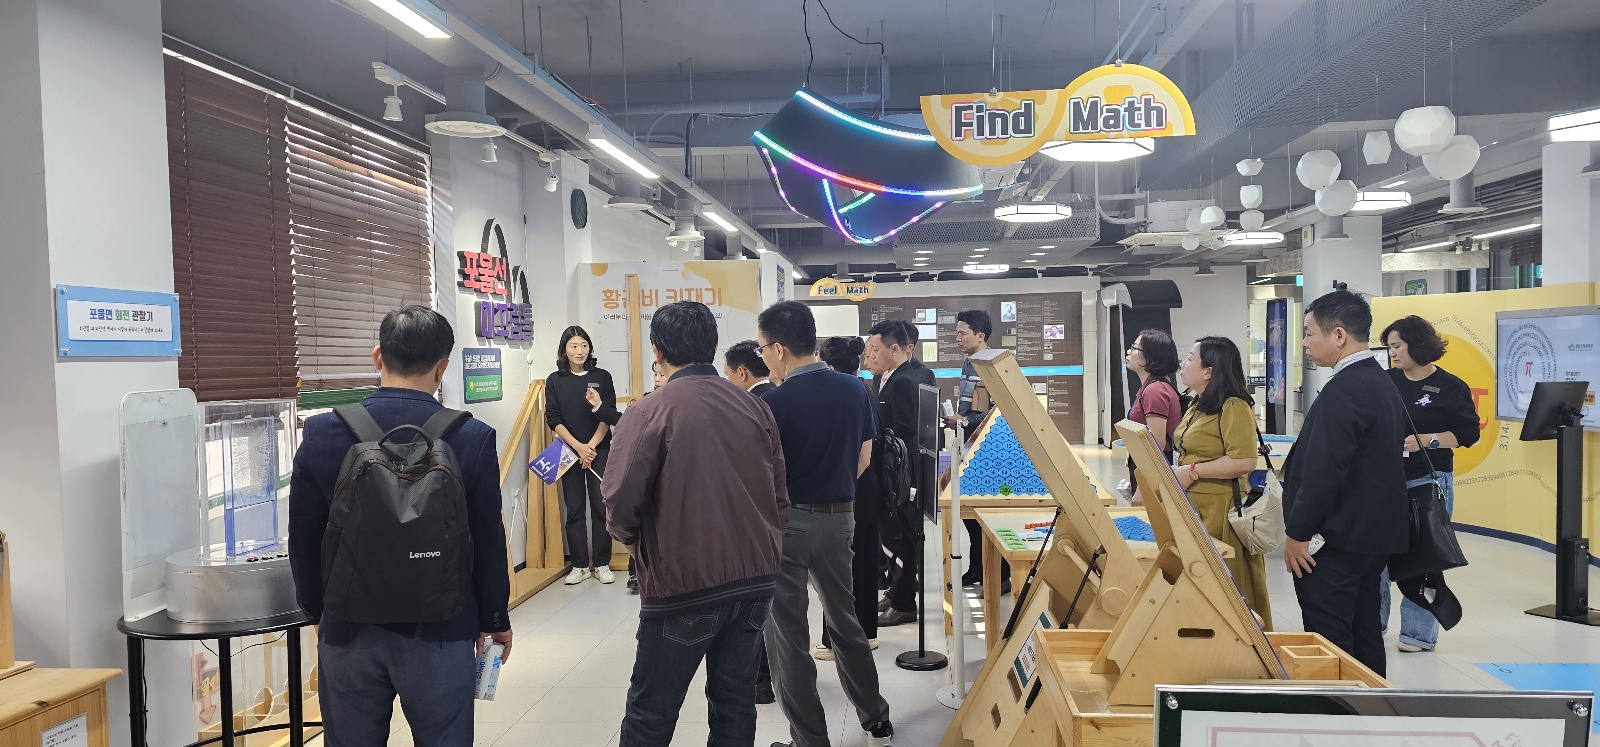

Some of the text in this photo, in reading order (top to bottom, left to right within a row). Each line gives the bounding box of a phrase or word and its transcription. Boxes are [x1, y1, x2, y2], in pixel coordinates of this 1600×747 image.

[951, 93, 1167, 141] Find Math
[462, 250, 508, 296] 포물선
[602, 287, 659, 309] 황비
[818, 285, 869, 295] Feel Math
[89, 308, 154, 322] 포물면 회전 관찰기
[409, 551, 441, 559] Lenovo
